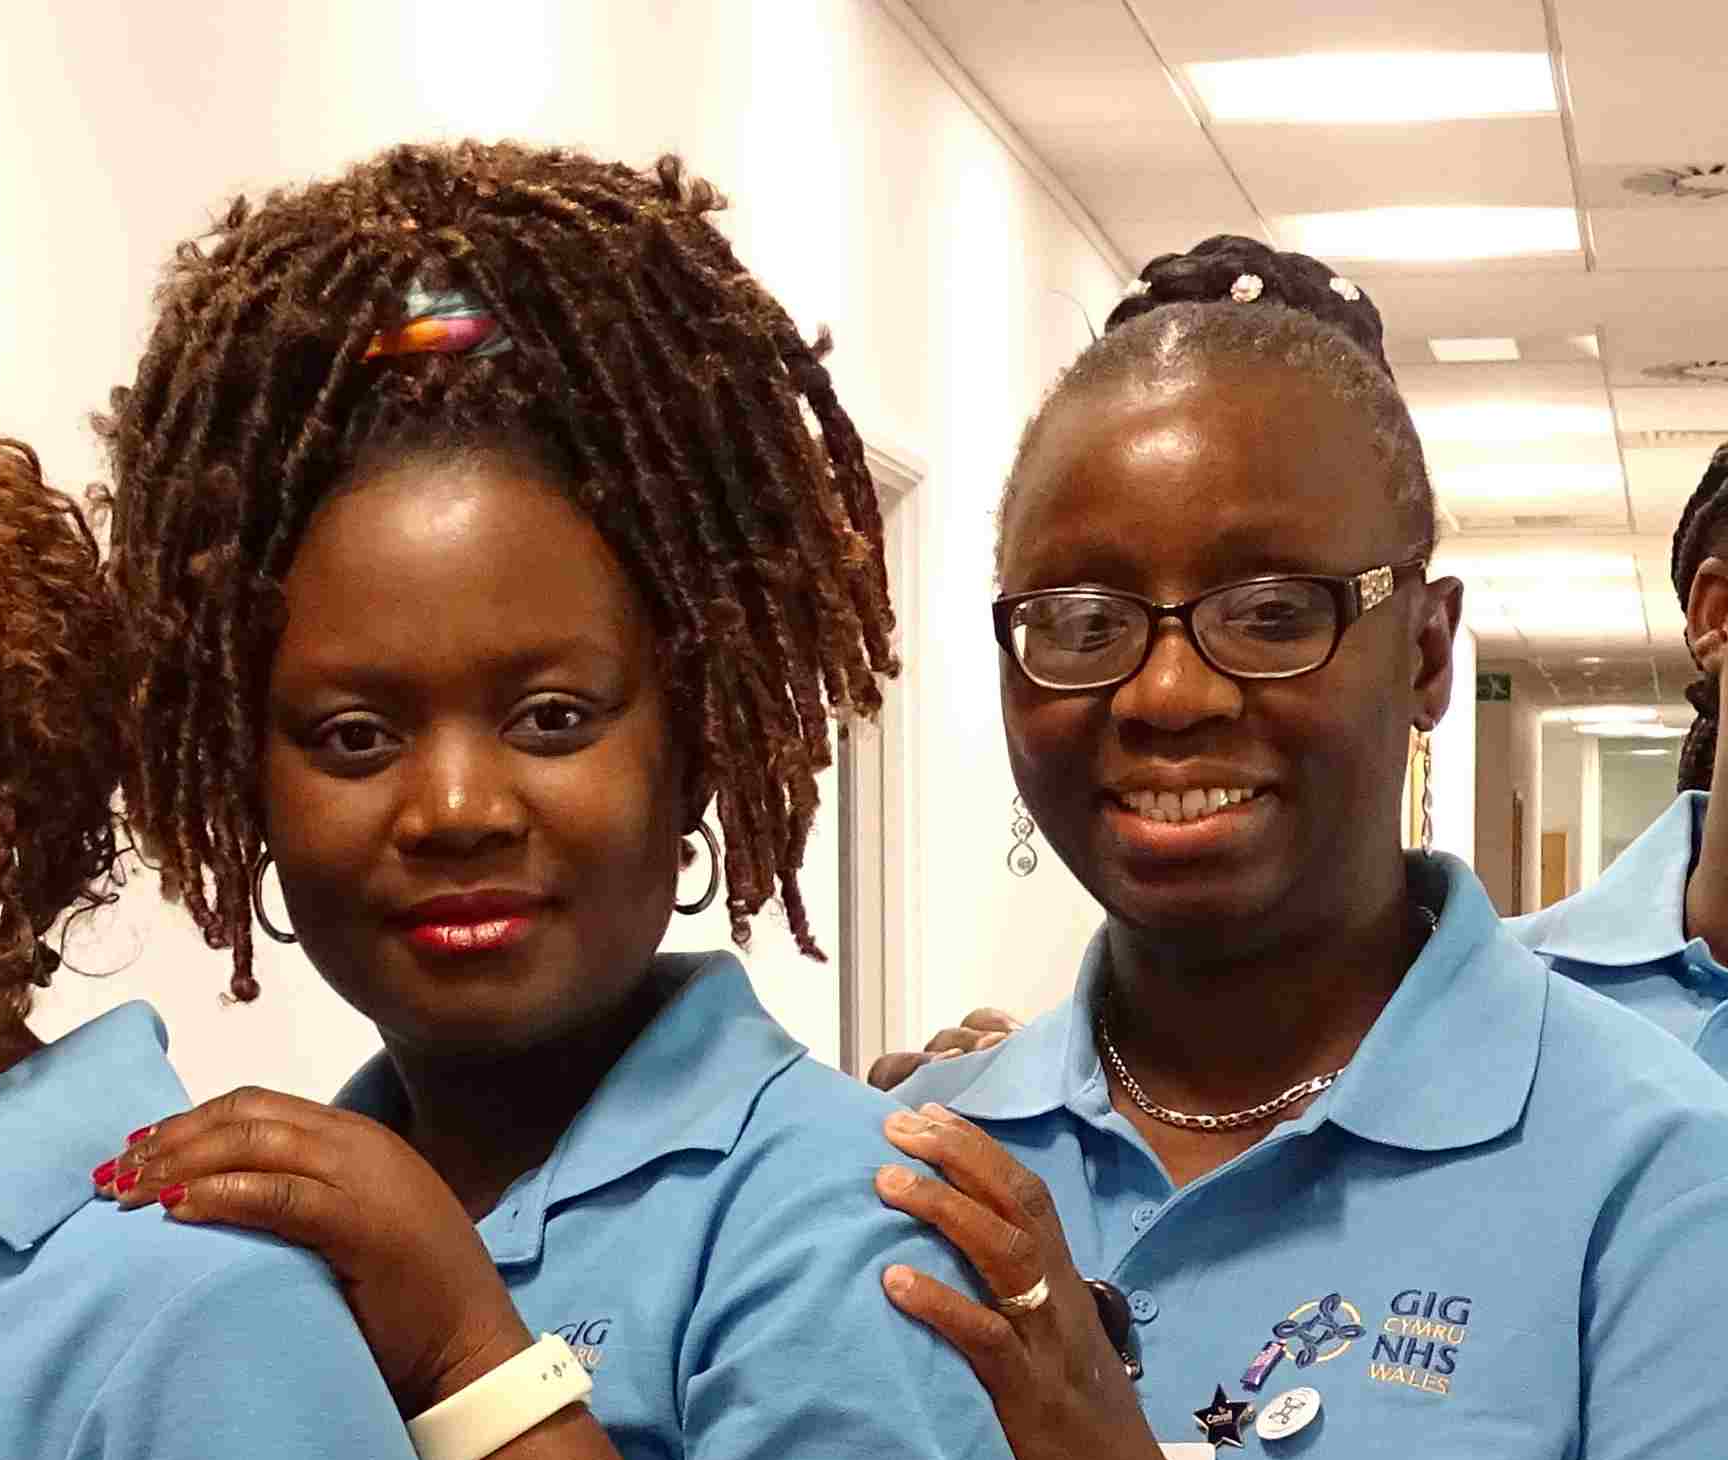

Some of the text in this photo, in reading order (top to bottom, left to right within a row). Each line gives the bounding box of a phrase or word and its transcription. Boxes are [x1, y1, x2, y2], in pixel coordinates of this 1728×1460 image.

[1391, 1290, 1472, 1325] GIG
[1384, 1318, 1465, 1344] CYMRU
[1372, 1334, 1458, 1374] NHS
[1368, 1363, 1450, 1393] WALES
